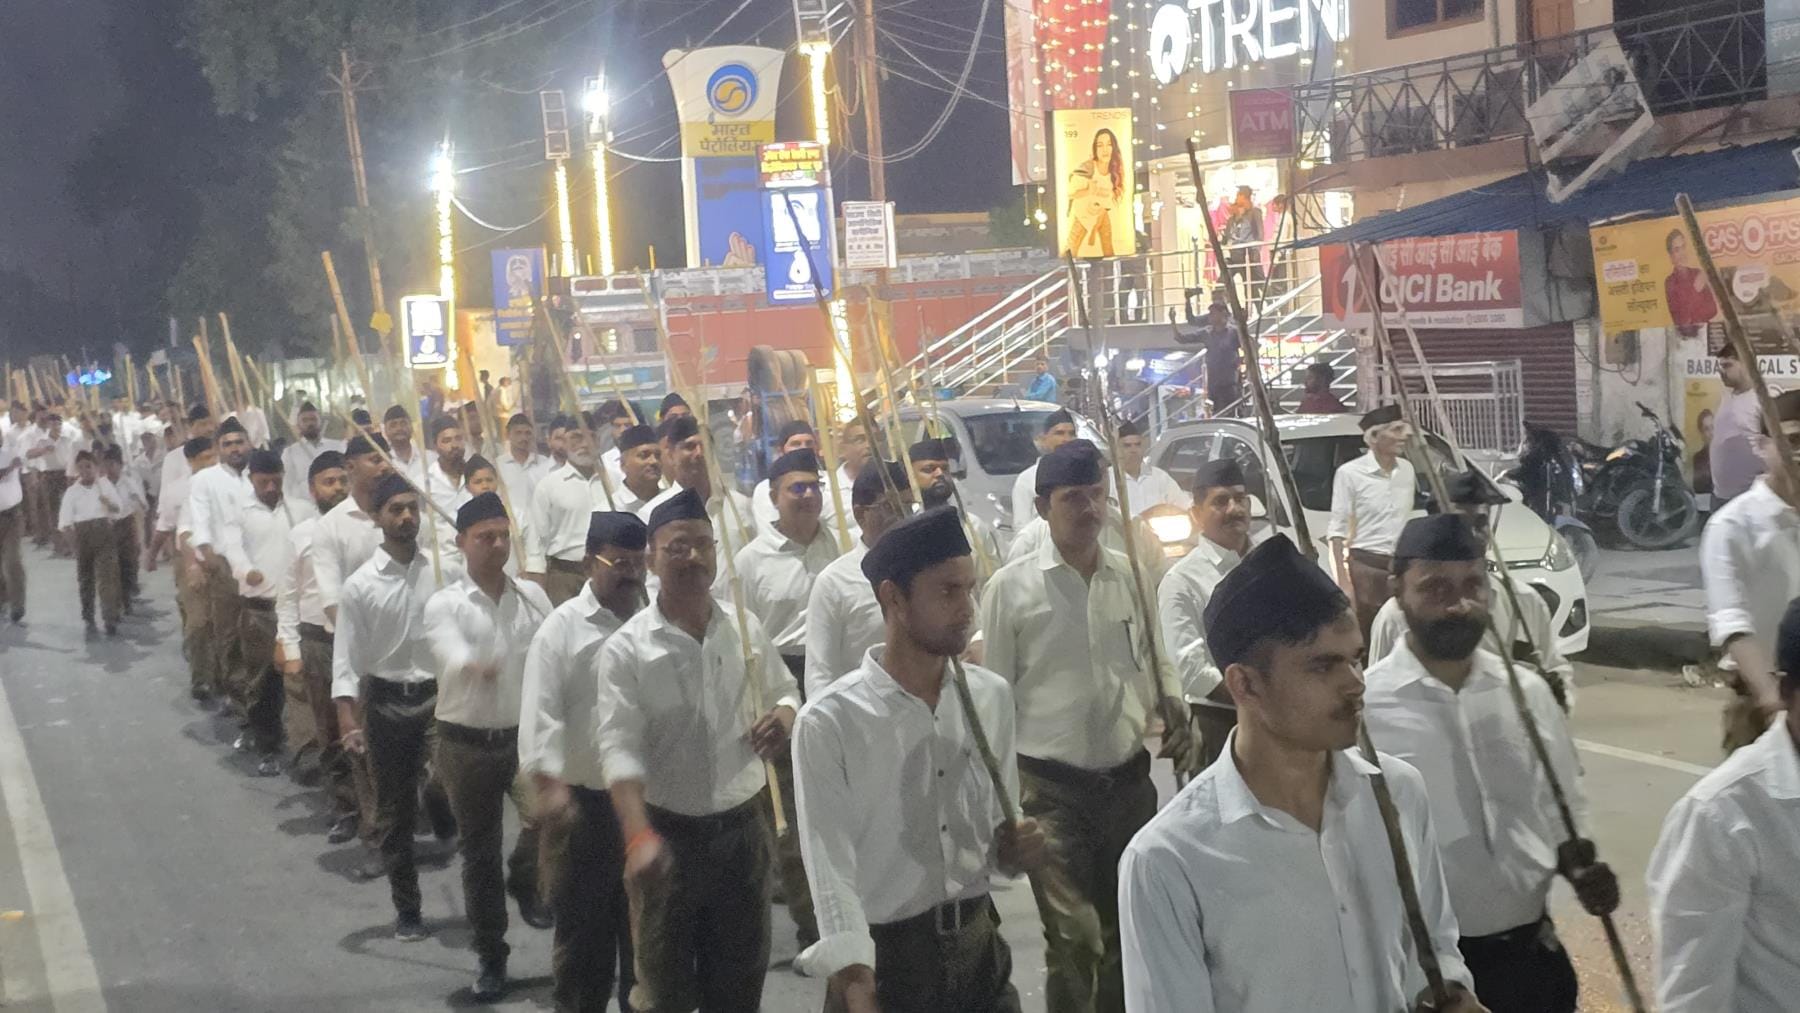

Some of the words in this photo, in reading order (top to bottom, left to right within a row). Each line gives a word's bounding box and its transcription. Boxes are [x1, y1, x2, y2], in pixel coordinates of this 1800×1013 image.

[711, 122, 751, 136] भारत
[1240, 110, 1289, 132] ATM
[1436, 270, 1503, 301] Bank
[1687, 359, 1721, 375] BABA
